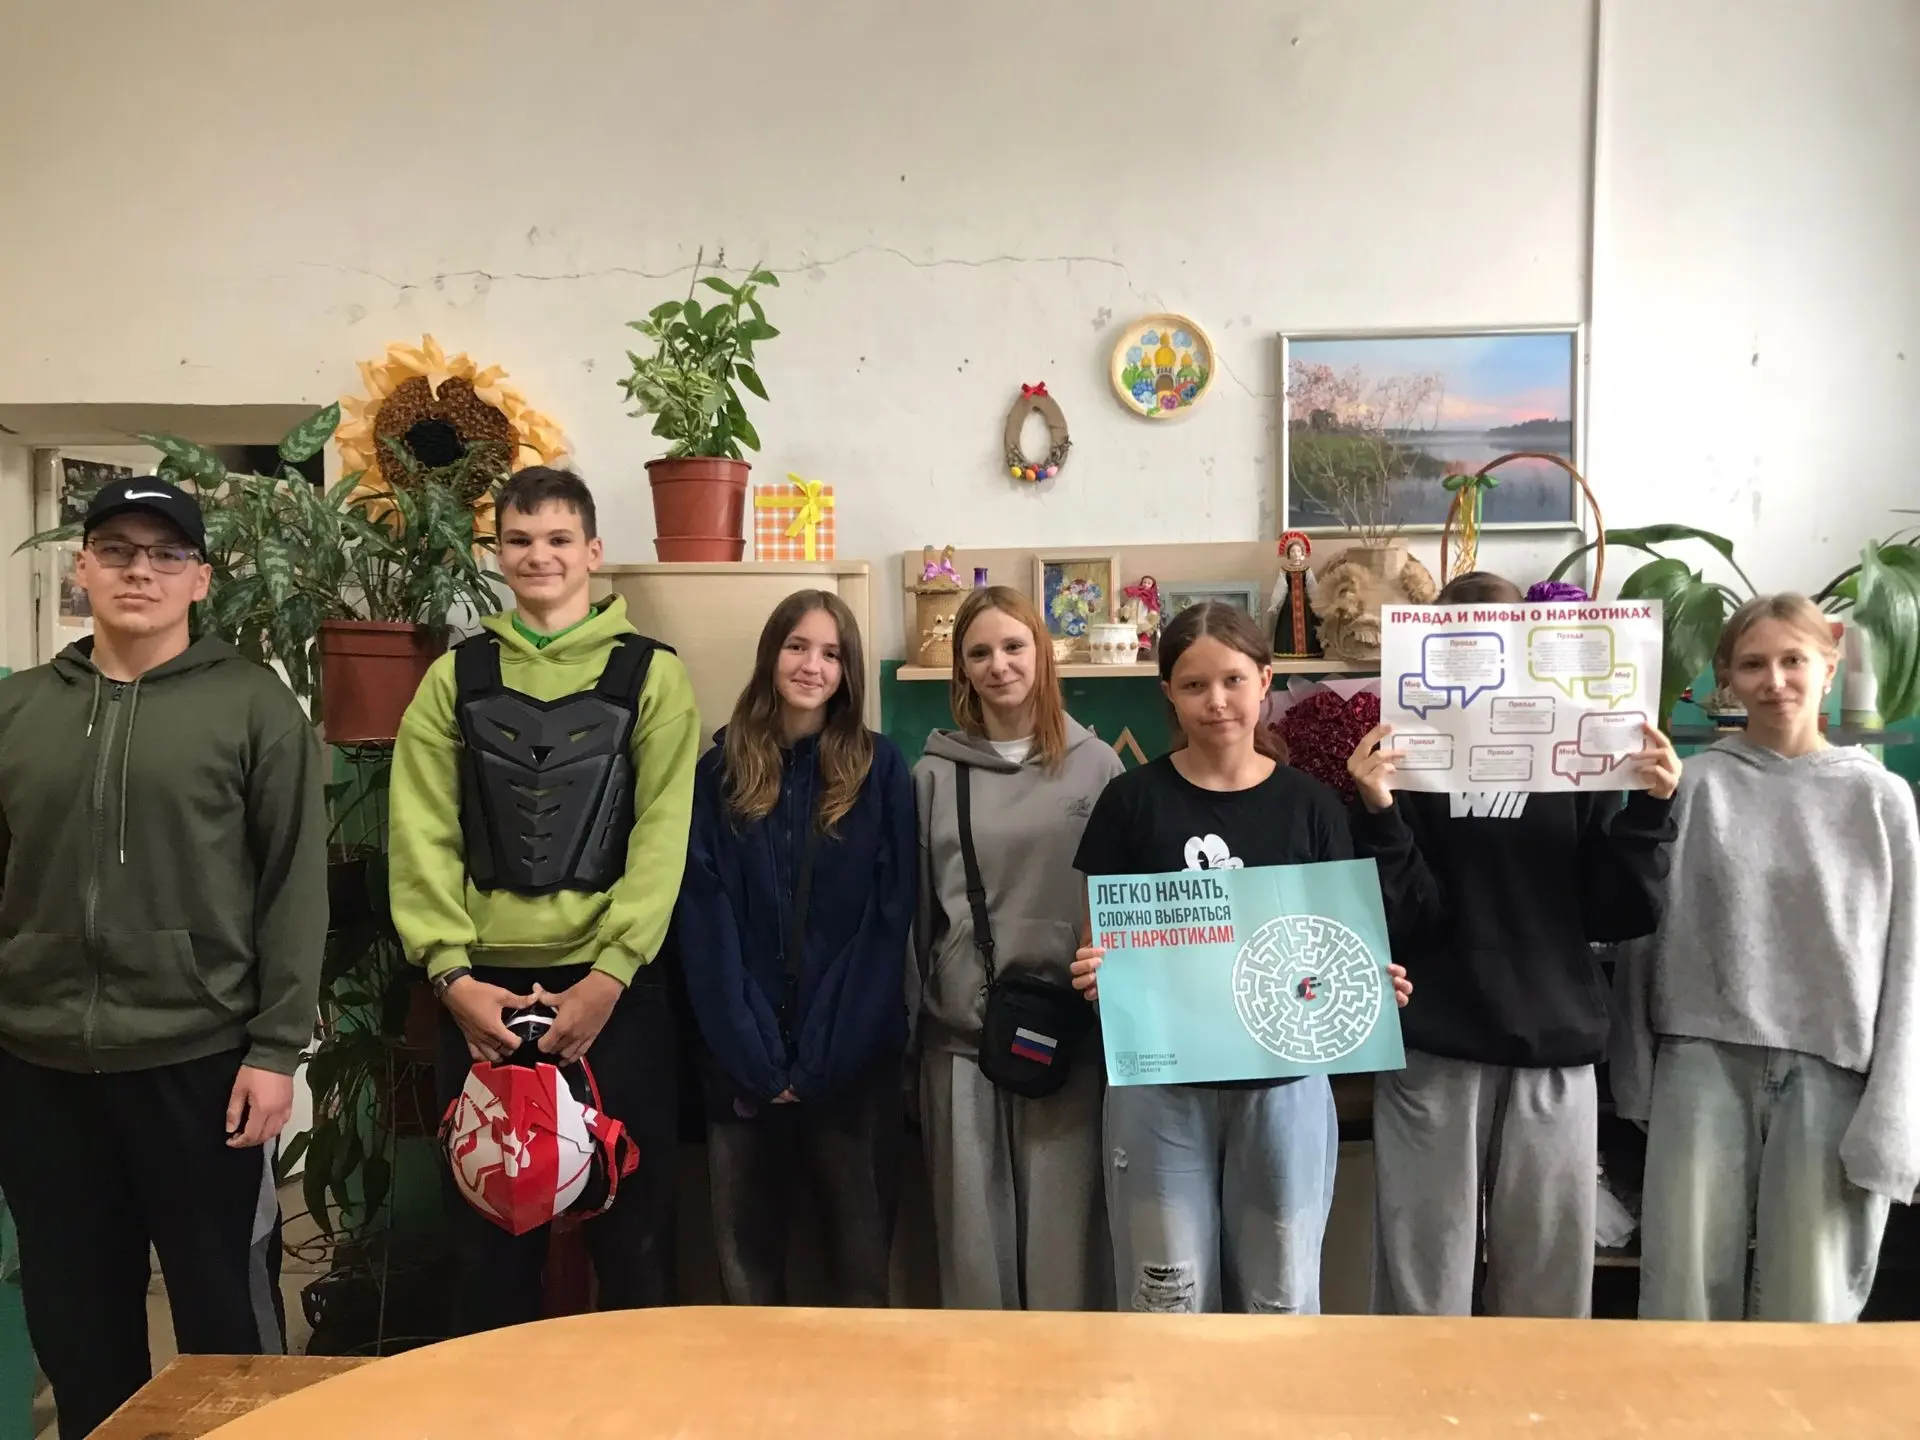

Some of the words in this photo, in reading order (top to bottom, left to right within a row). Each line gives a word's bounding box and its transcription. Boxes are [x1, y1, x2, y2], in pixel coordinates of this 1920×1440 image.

[1391, 611, 1453, 626] ПРАВДА
[1457, 611, 1468, 623] И
[1473, 610, 1526, 623] МИФЫ
[1531, 610, 1541, 621] О
[1547, 606, 1652, 621] НАРКОТИКАХ
[1449, 640, 1478, 648] Правда
[1508, 700, 1536, 709] Правда
[1096, 882, 1151, 905] ЛЕГКО
[1156, 878, 1229, 903] НАЧАТЬ,
[1098, 908, 1152, 927] СЛОЖНО
[1155, 905, 1231, 925] ВЫБРАТЬСЯ
[1100, 931, 1127, 949] НЕТ
[1132, 925, 1235, 948] НАРКОТИКАМ!
